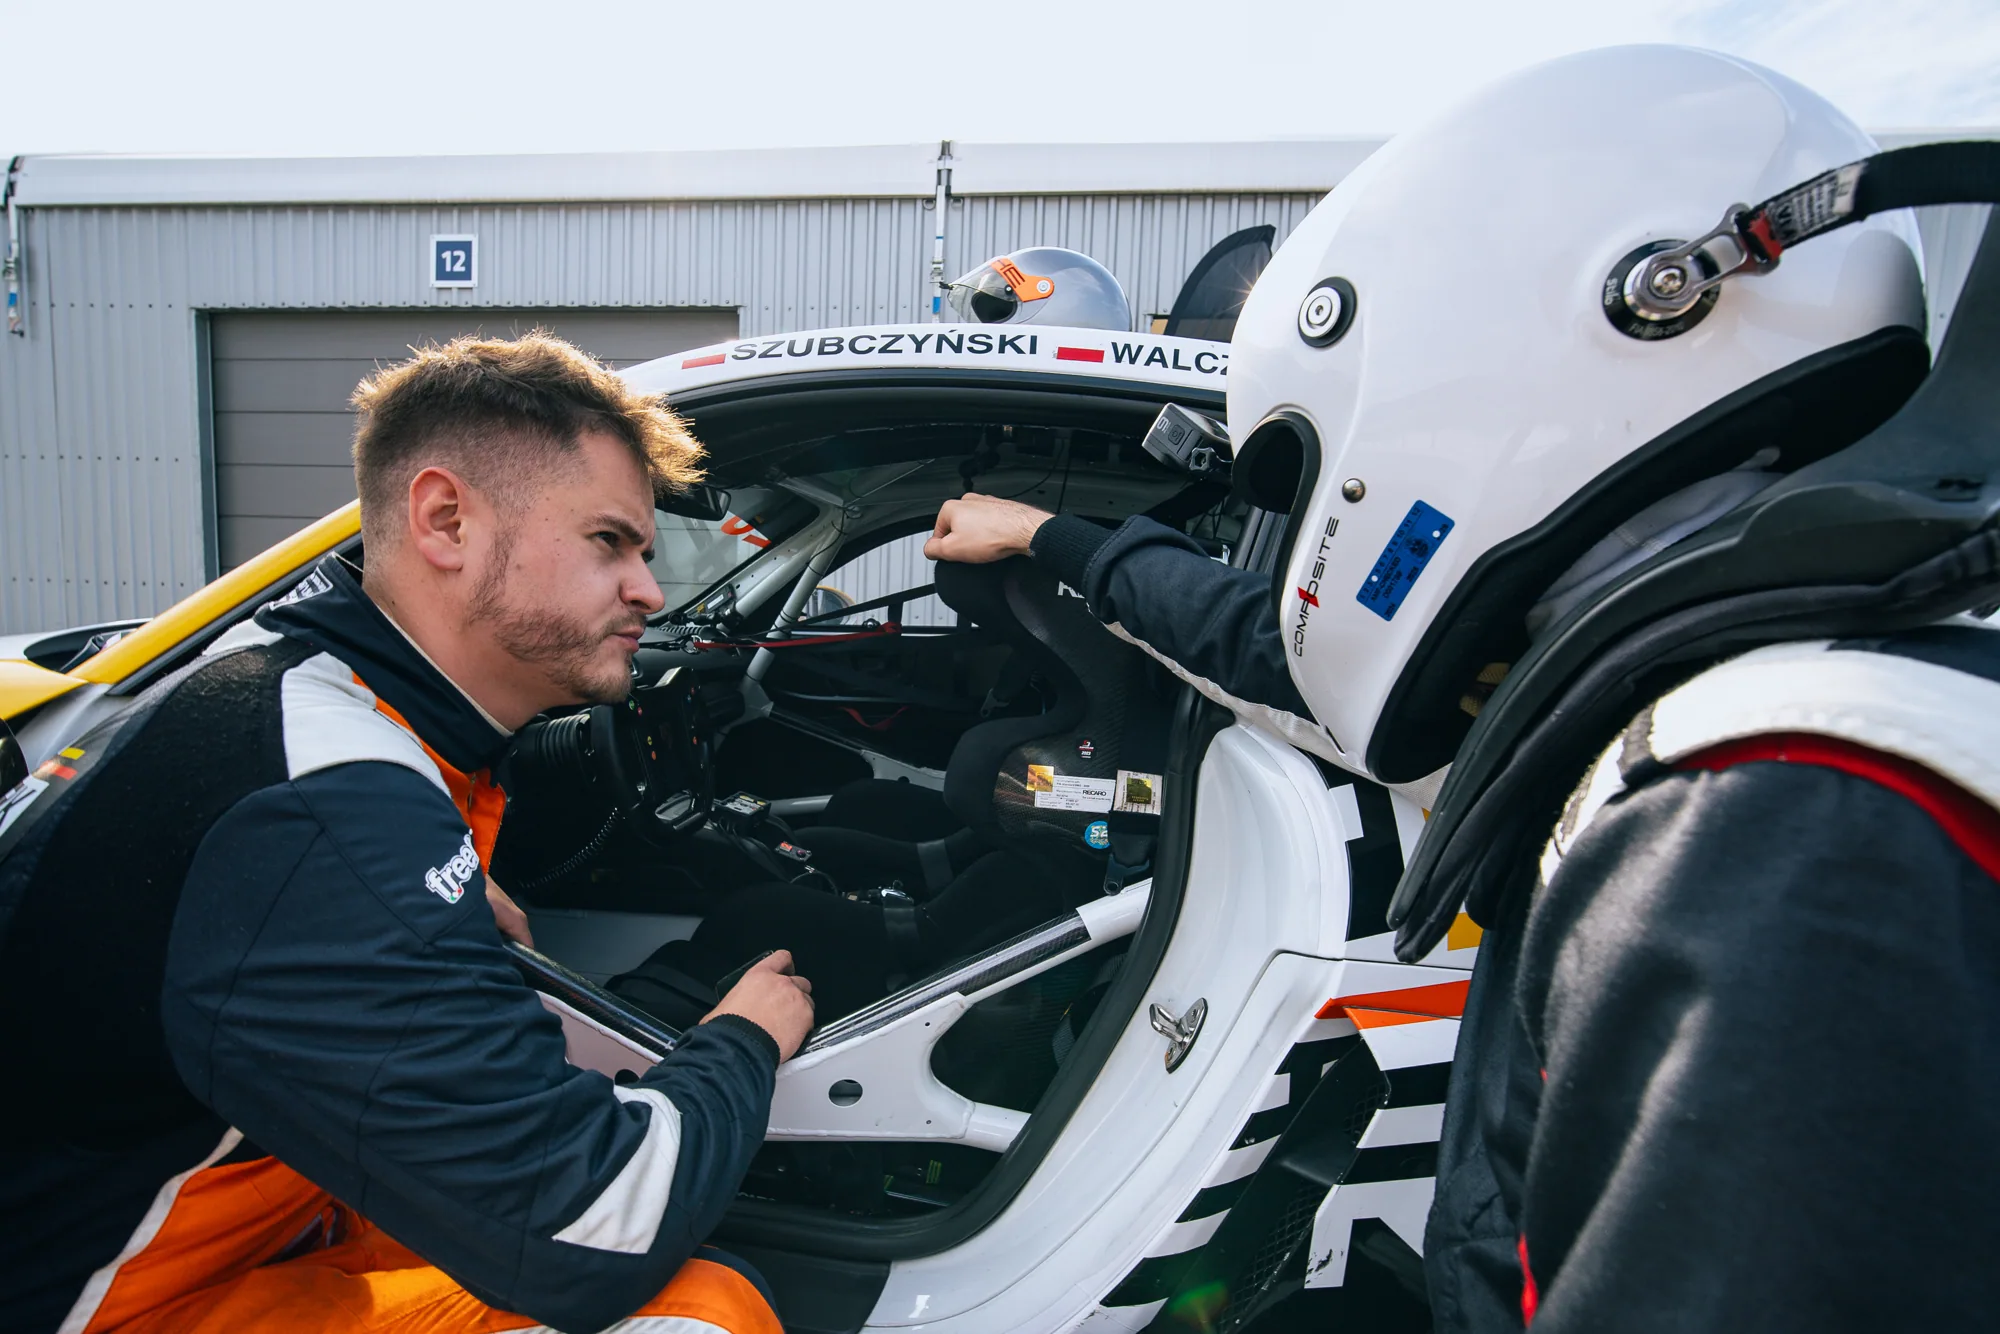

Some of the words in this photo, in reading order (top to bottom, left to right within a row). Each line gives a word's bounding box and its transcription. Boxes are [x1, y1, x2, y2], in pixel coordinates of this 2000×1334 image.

[441, 250, 466, 272] 12
[731, 329, 1038, 361] SZUBCZYŃSKI
[1294, 516, 1340, 657] COMPOSITE
[1082, 789, 1107, 797] RECARO
[425, 828, 480, 905] free
